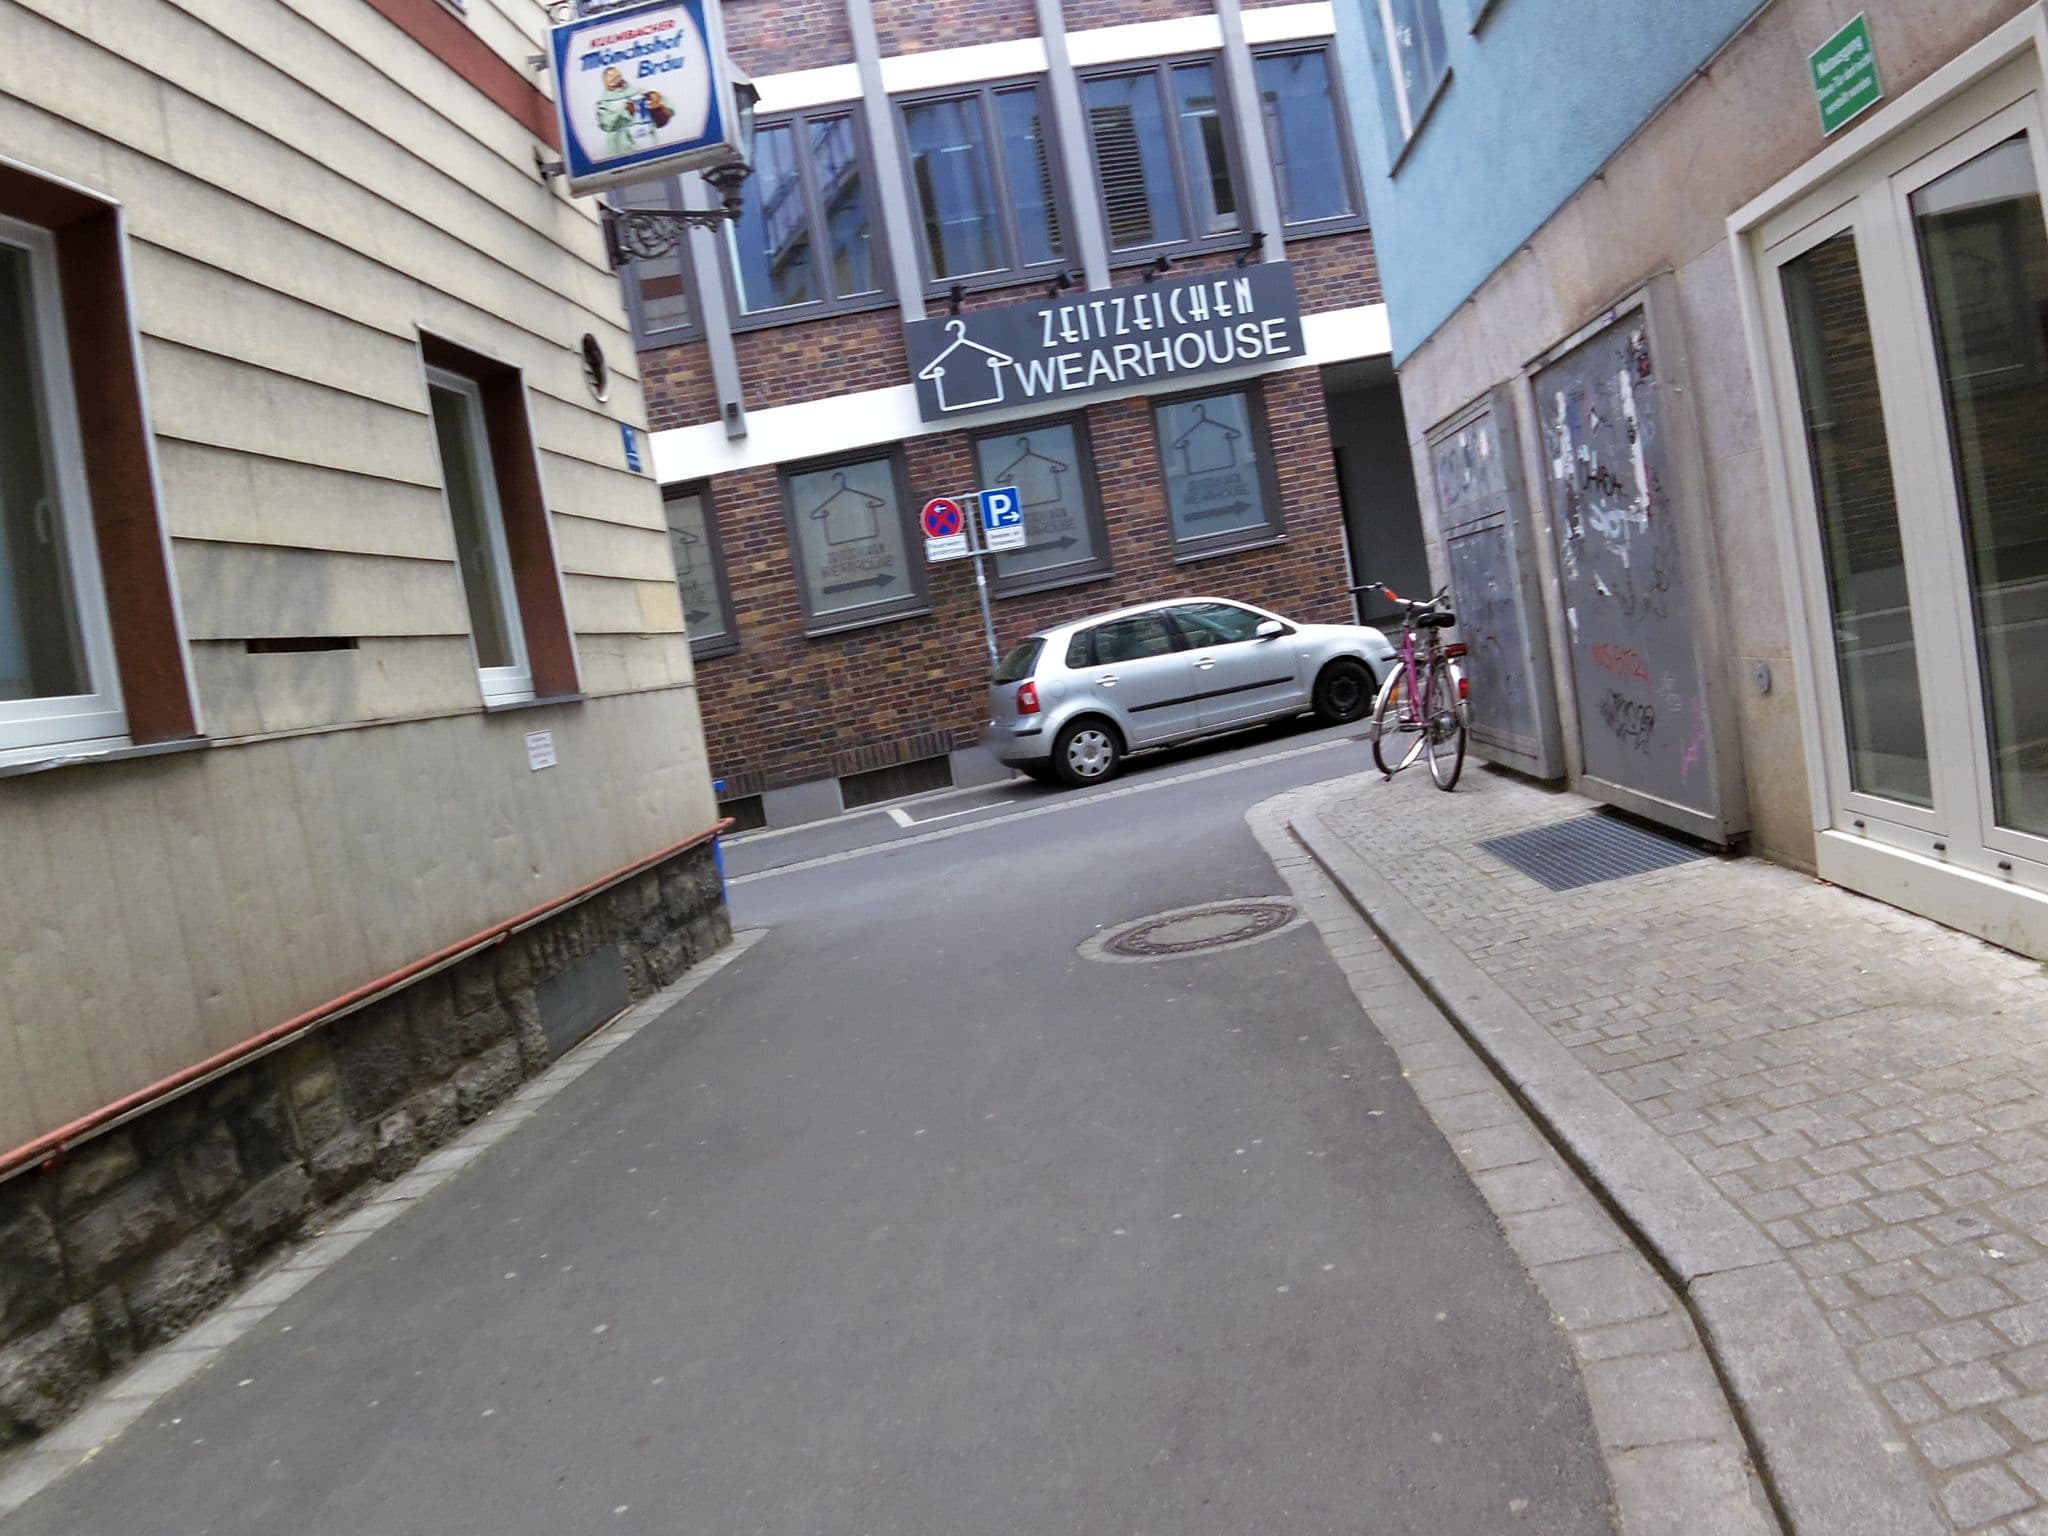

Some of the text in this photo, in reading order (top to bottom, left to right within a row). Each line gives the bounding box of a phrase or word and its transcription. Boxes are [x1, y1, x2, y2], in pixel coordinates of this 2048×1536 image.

[580, 29, 684, 71] Mönchshof
[590, 19, 675, 48] KULMBACHER
[637, 55, 685, 78] Bräu
[1038, 277, 1254, 348] ZEITZEICHEN
[1014, 317, 1291, 397] WEARHOUSE
[988, 493, 1012, 527] P
